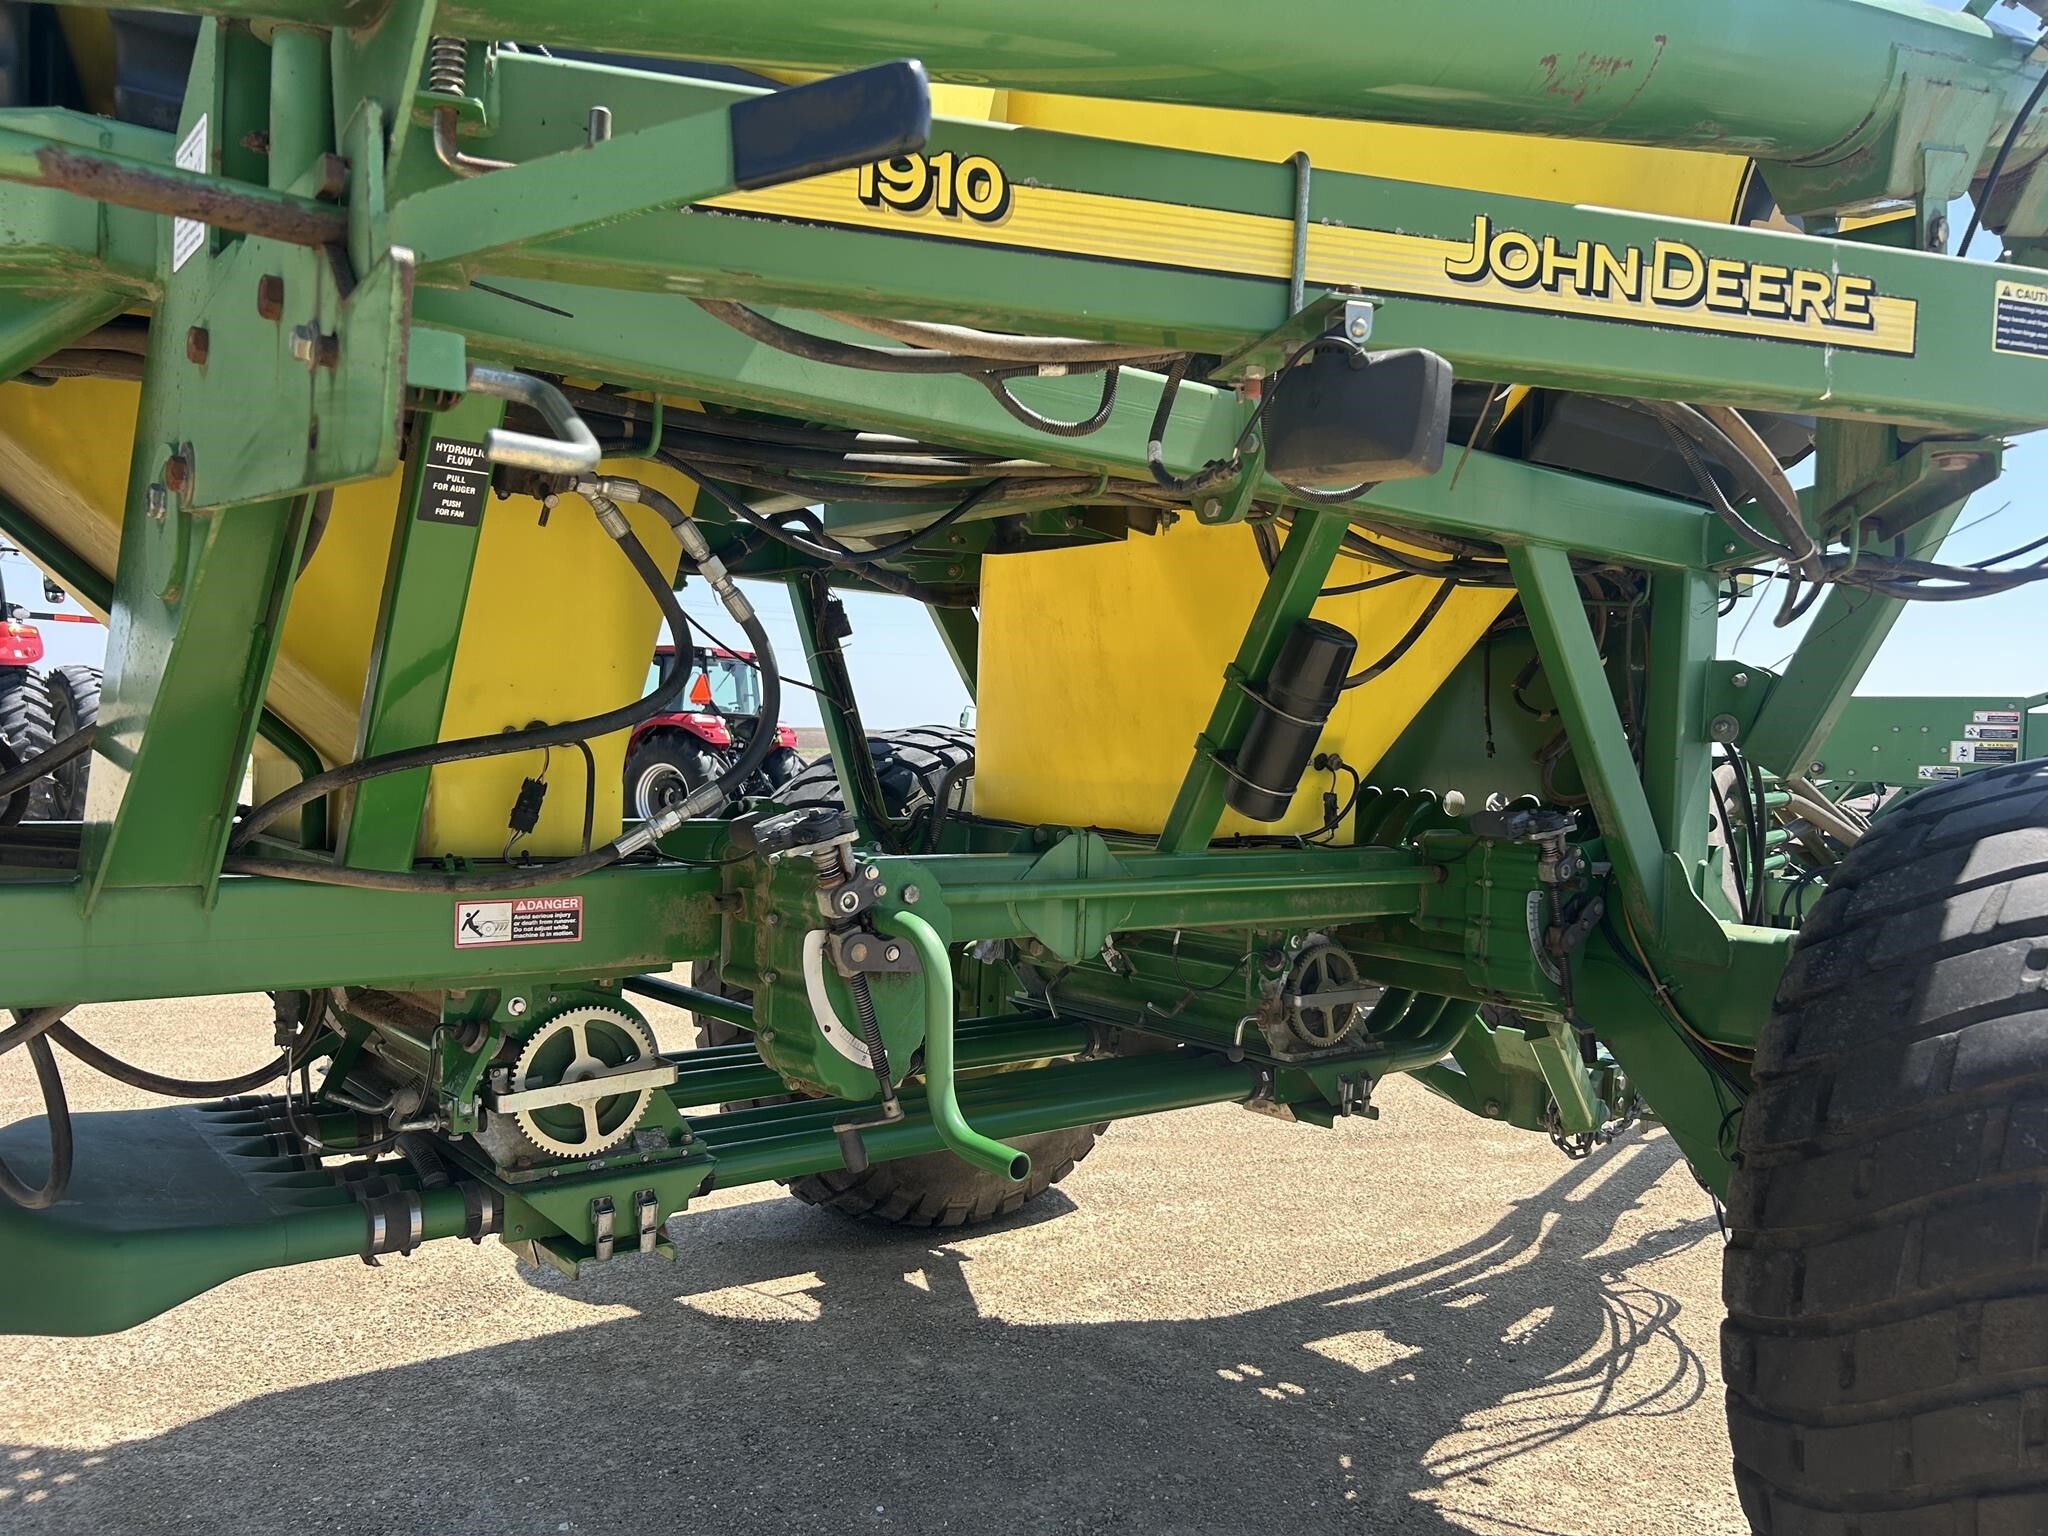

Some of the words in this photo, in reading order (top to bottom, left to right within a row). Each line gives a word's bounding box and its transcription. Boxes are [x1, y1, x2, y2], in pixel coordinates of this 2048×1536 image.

[859, 151, 1011, 223] 1910
[1445, 215, 1643, 306] JOHN
[1651, 237, 1875, 331] DEERE
[446, 454, 474, 466] FLOW
[446, 474, 466, 484] PULL
[432, 482, 449, 491] FOR
[449, 484, 476, 495] AUGER
[441, 498, 462, 508] PUSH
[434, 507, 450, 516] FOR
[449, 509, 465, 518] FAN
[527, 898, 579, 910] DANGER
[554, 911, 572, 919] injury
